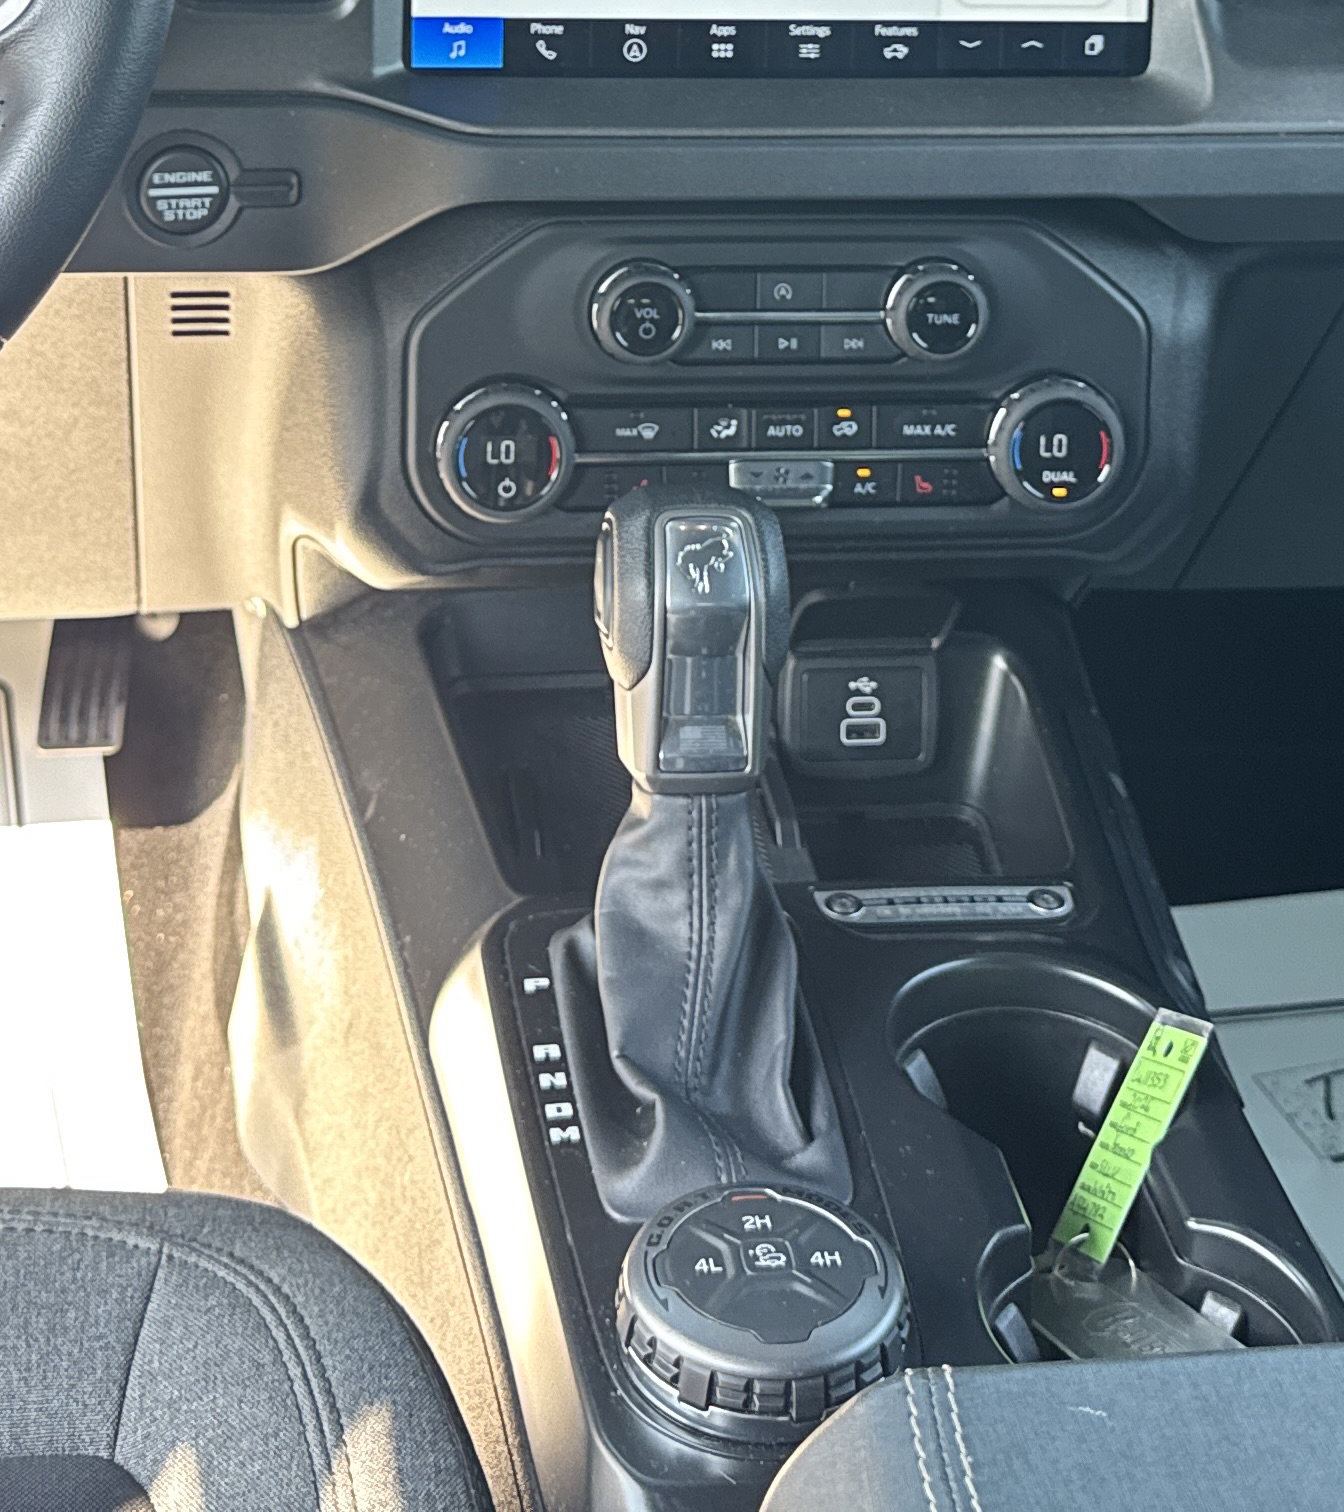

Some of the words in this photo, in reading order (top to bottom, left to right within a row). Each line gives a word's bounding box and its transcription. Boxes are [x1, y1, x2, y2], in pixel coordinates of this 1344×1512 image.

[442, 22, 474, 34] Audio
[530, 22, 565, 35] Phone
[624, 23, 647, 35] Nav
[709, 24, 737, 37] Apps
[788, 24, 832, 38] Settings
[874, 24, 919, 37] Features
[152, 170, 214, 184] ENGINE
[156, 197, 213, 211] START
[163, 208, 209, 222] STOP
[634, 307, 660, 319] VOL
[926, 313, 961, 326] TUNE
[615, 427, 638, 437] MAX
[766, 424, 804, 437] AUTO
[902, 424, 930, 437] MAX
[933, 424, 956, 437] A/C
[1042, 470, 1077, 484] DUAL
[853, 480, 876, 494] A/C
[523, 977, 550, 994] P
[538, 1071, 567, 1090] N
[544, 1102, 574, 1122] D
[549, 1125, 581, 1145] M
[742, 1214, 772, 1232] 2H
[810, 1250, 842, 1268] 4H
[694, 1257, 723, 1276] 4L
